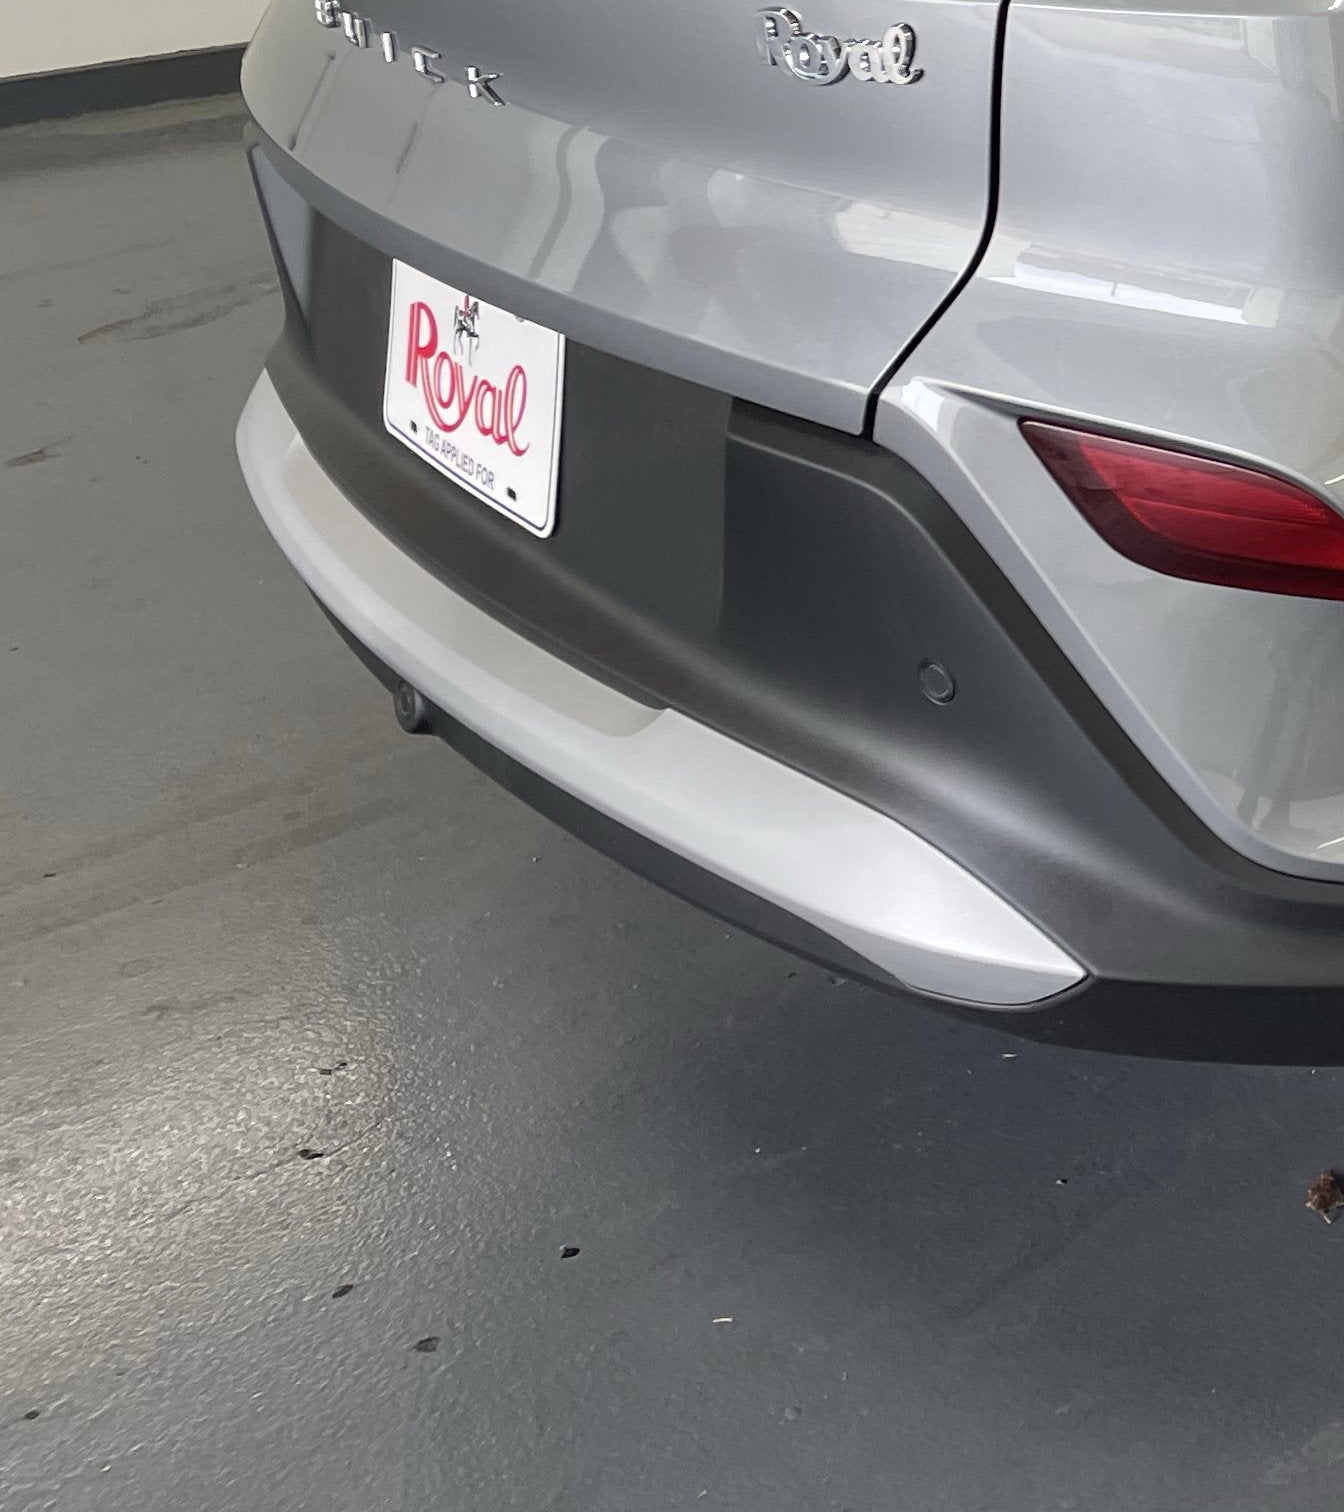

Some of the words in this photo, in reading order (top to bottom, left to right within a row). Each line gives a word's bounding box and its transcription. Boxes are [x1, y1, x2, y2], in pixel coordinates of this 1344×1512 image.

[752, 6, 924, 86] Royal
[405, 301, 529, 456] Royal
[425, 426, 440, 452] TAG
[440, 439, 474, 476] APPLIED
[476, 463, 495, 491] FOR
